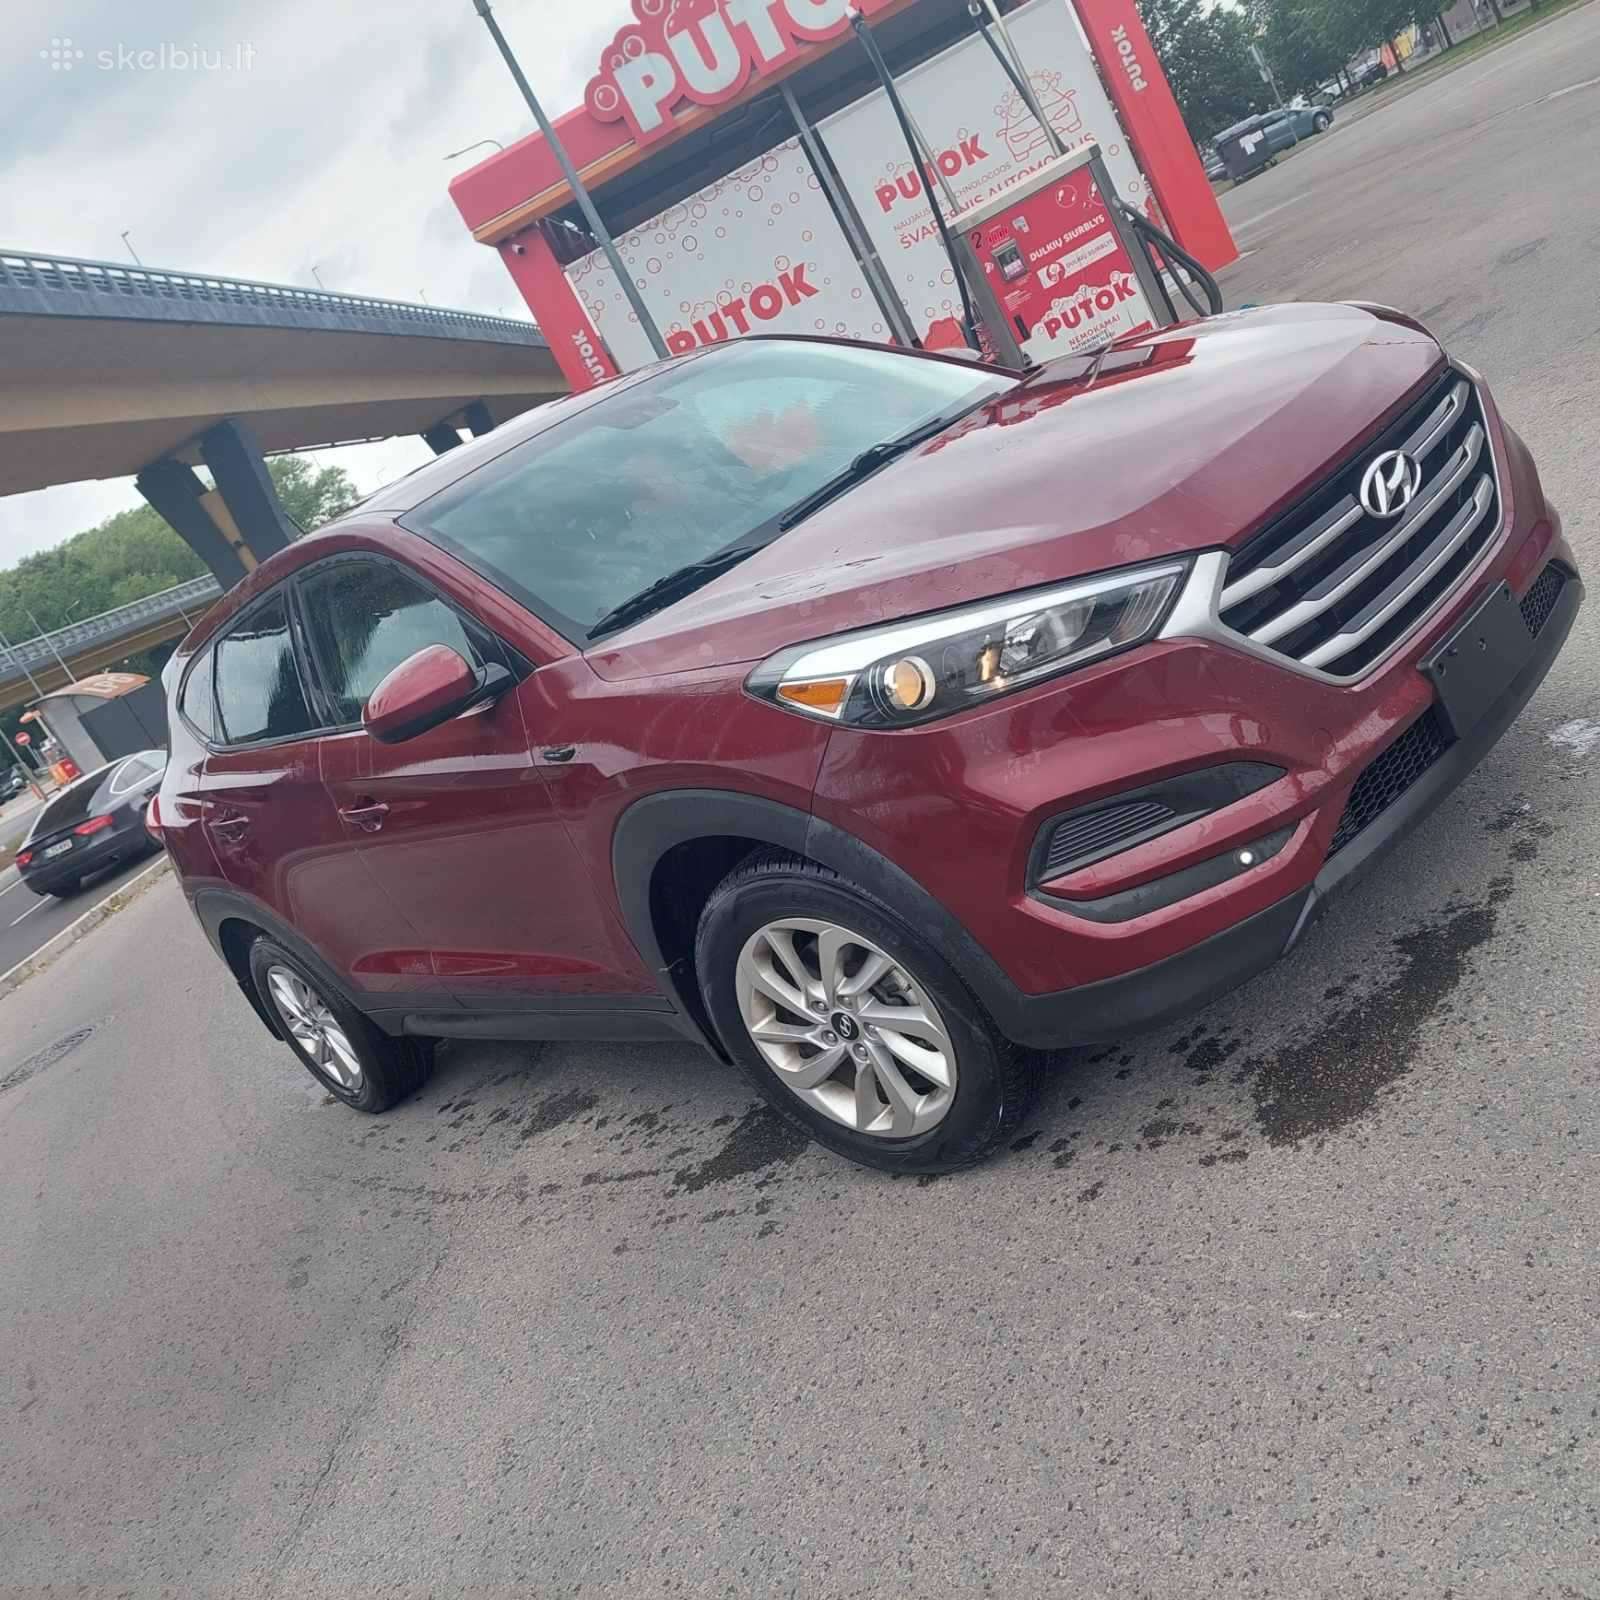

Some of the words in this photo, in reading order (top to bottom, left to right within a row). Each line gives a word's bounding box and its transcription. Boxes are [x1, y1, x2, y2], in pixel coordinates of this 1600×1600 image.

[1111, 24, 1148, 92] PUTOK
[970, 231, 984, 250] 2
[666, 263, 819, 356] PUTOK
[1043, 277, 1137, 340] PUTOK
[571, 329, 608, 384] UTOK
